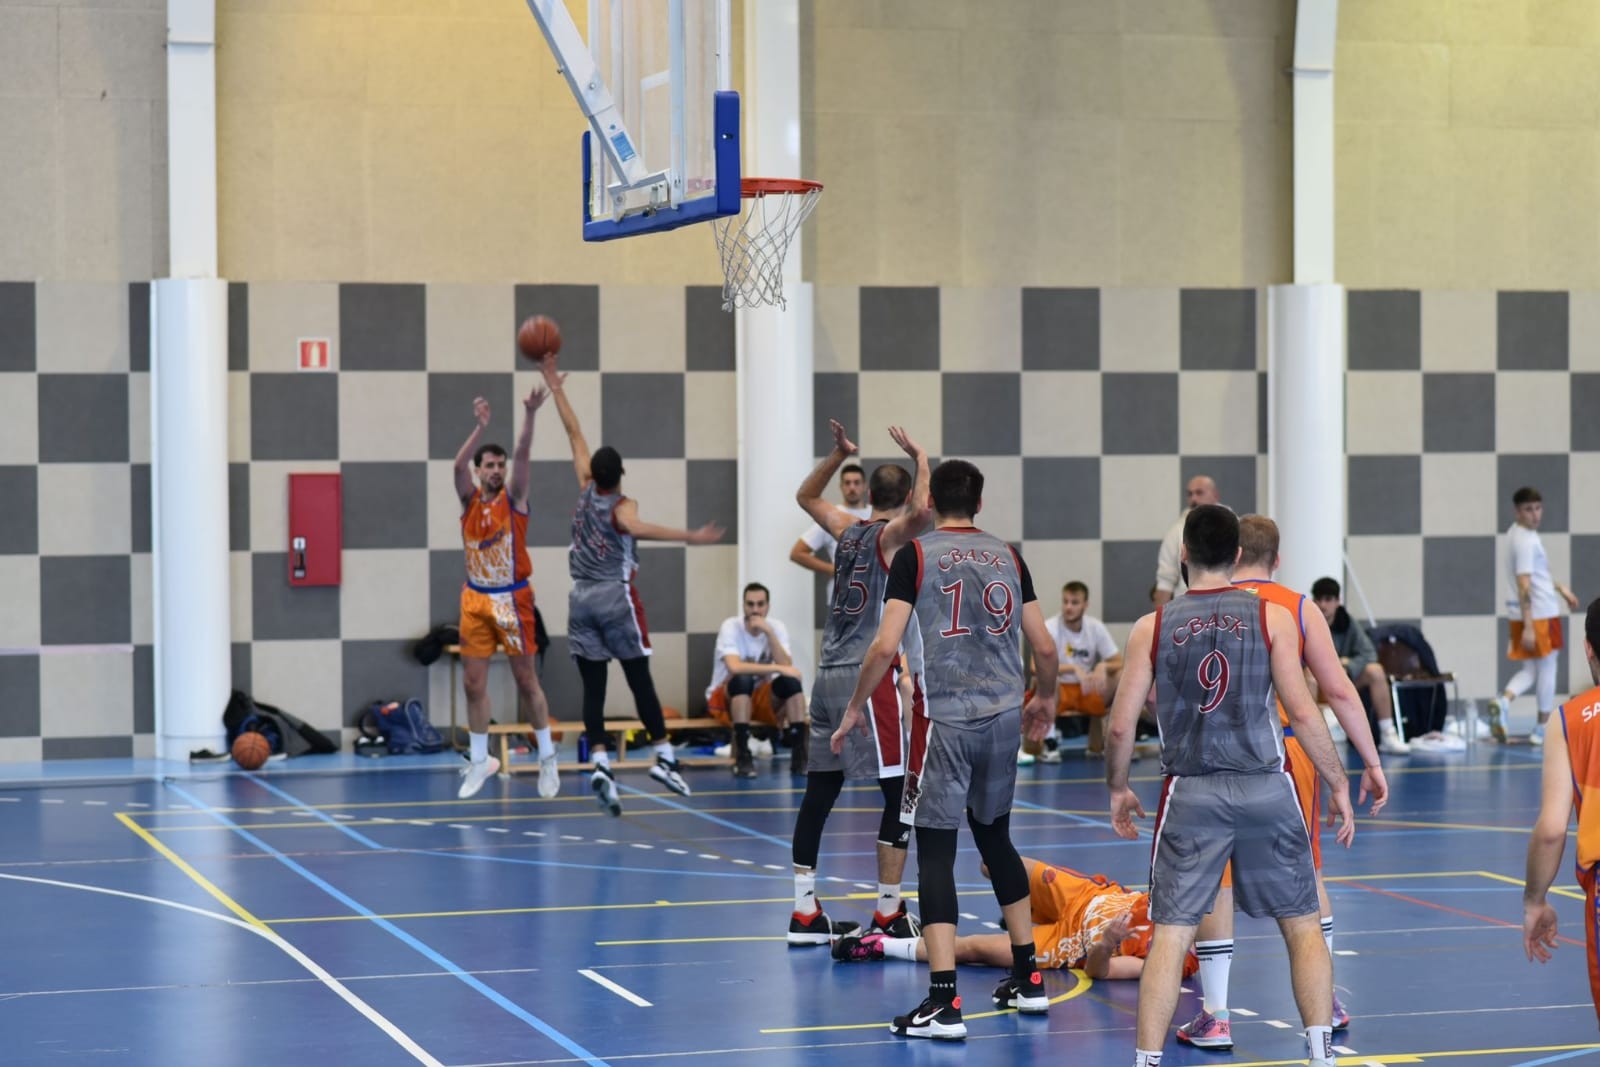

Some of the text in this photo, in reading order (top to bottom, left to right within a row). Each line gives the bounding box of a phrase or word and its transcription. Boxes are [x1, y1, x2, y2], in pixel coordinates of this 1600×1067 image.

[938, 548, 1008, 575] CBASK
[939, 579, 1014, 638] 19
[1173, 613, 1248, 646] CBASK
[1197, 649, 1230, 714] 9
